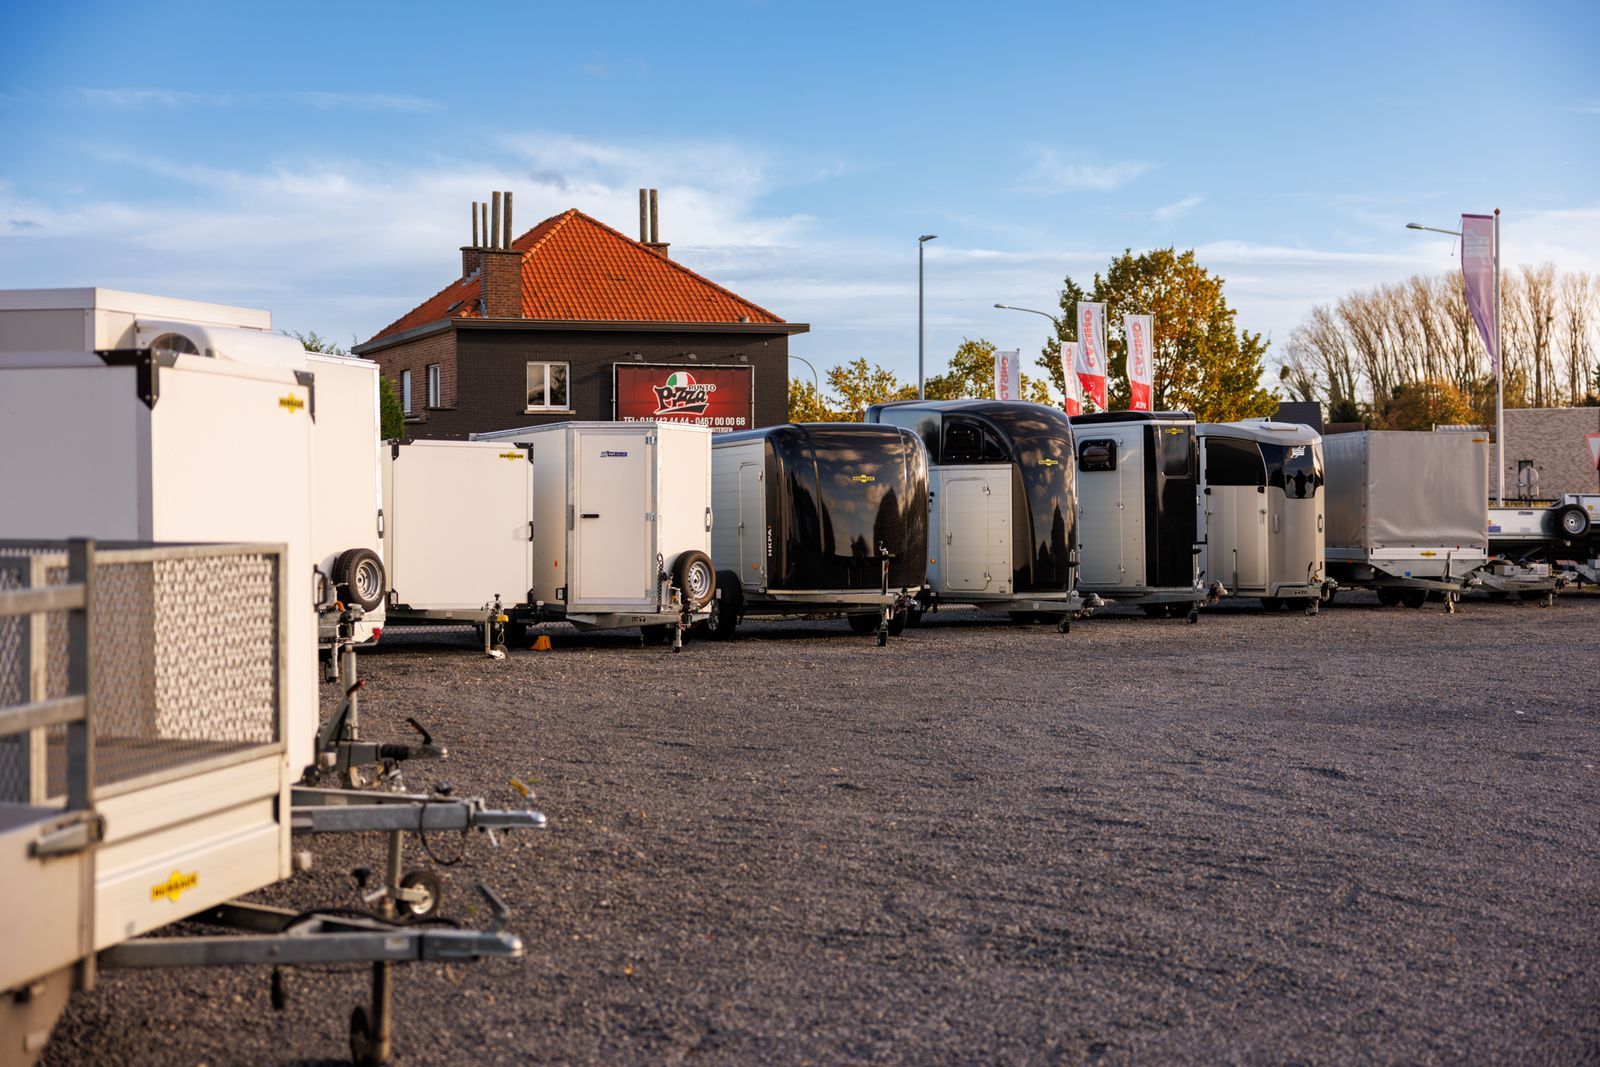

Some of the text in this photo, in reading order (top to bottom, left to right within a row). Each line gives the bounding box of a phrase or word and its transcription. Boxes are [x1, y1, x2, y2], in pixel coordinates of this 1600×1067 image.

[696, 417, 714, 426] 0467
[714, 417, 724, 426] 00
[725, 417, 734, 426] 00
[736, 417, 746, 426] 68
